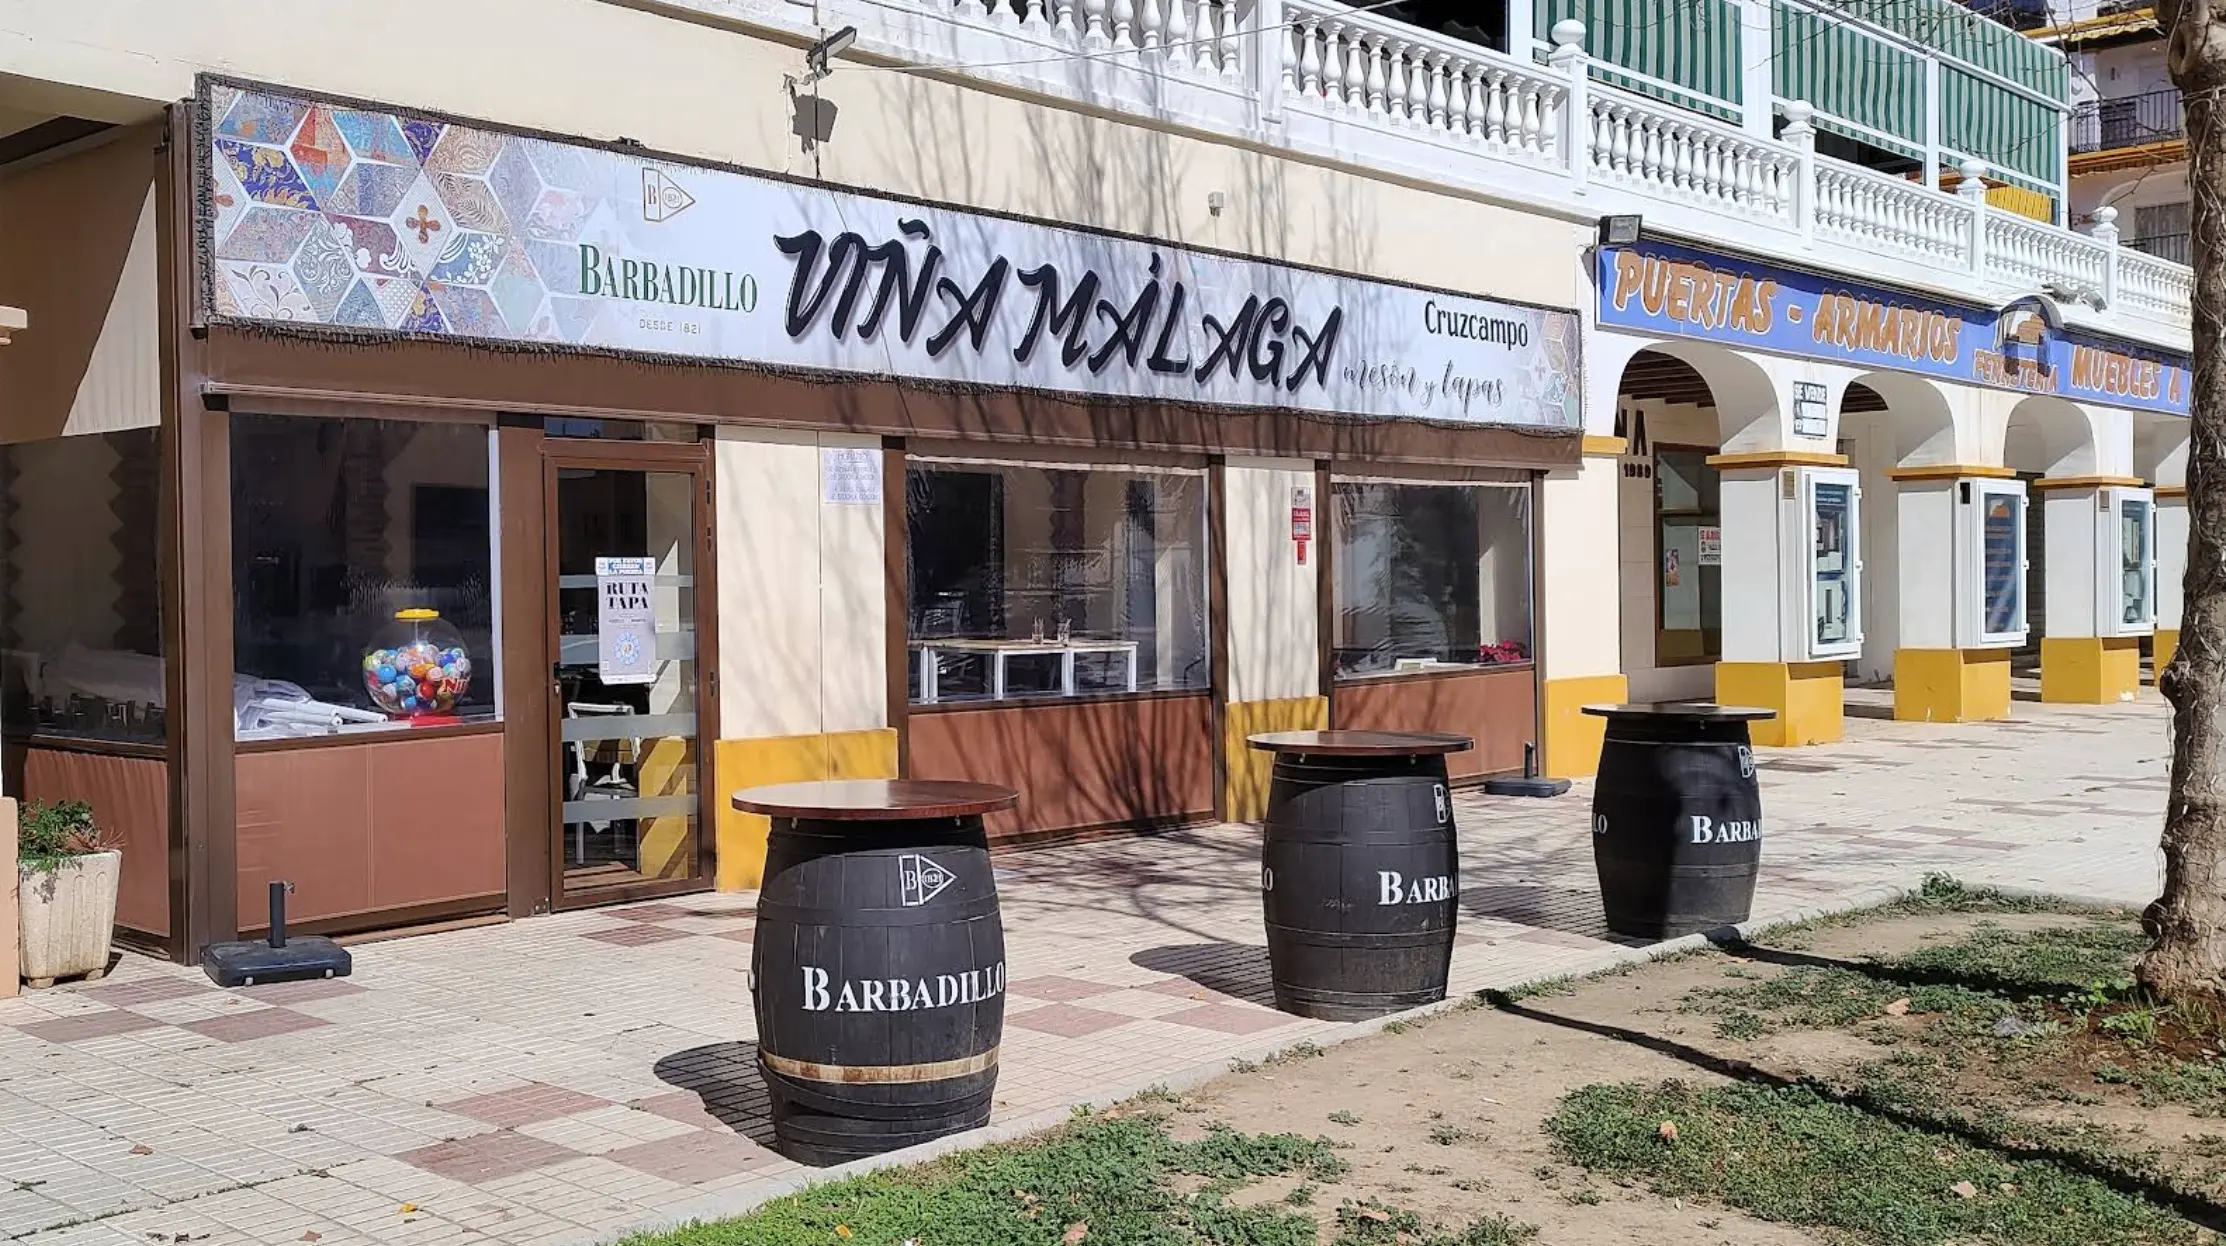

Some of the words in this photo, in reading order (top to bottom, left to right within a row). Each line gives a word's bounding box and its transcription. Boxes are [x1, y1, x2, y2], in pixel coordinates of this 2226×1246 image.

[579, 244, 757, 313] BARBADILLO
[639, 319, 673, 332] DESDE
[680, 322, 701, 335] 1821
[773, 218, 1008, 357] VIÑA
[1013, 251, 1342, 392] MÁLAGA
[1425, 300, 1528, 351] Cruzcampo
[1613, 249, 1778, 336] PUERTAS
[1813, 288, 1962, 365] ARMARIOS
[1419, 378, 1438, 408] y
[1440, 359, 1507, 417] tapas
[2071, 344, 2162, 400] MUEBLES
[606, 582, 648, 595] RUTA
[606, 596, 648, 610] TAPA
[906, 871, 917, 890] B
[801, 961, 1005, 1012] BARBADILLO
